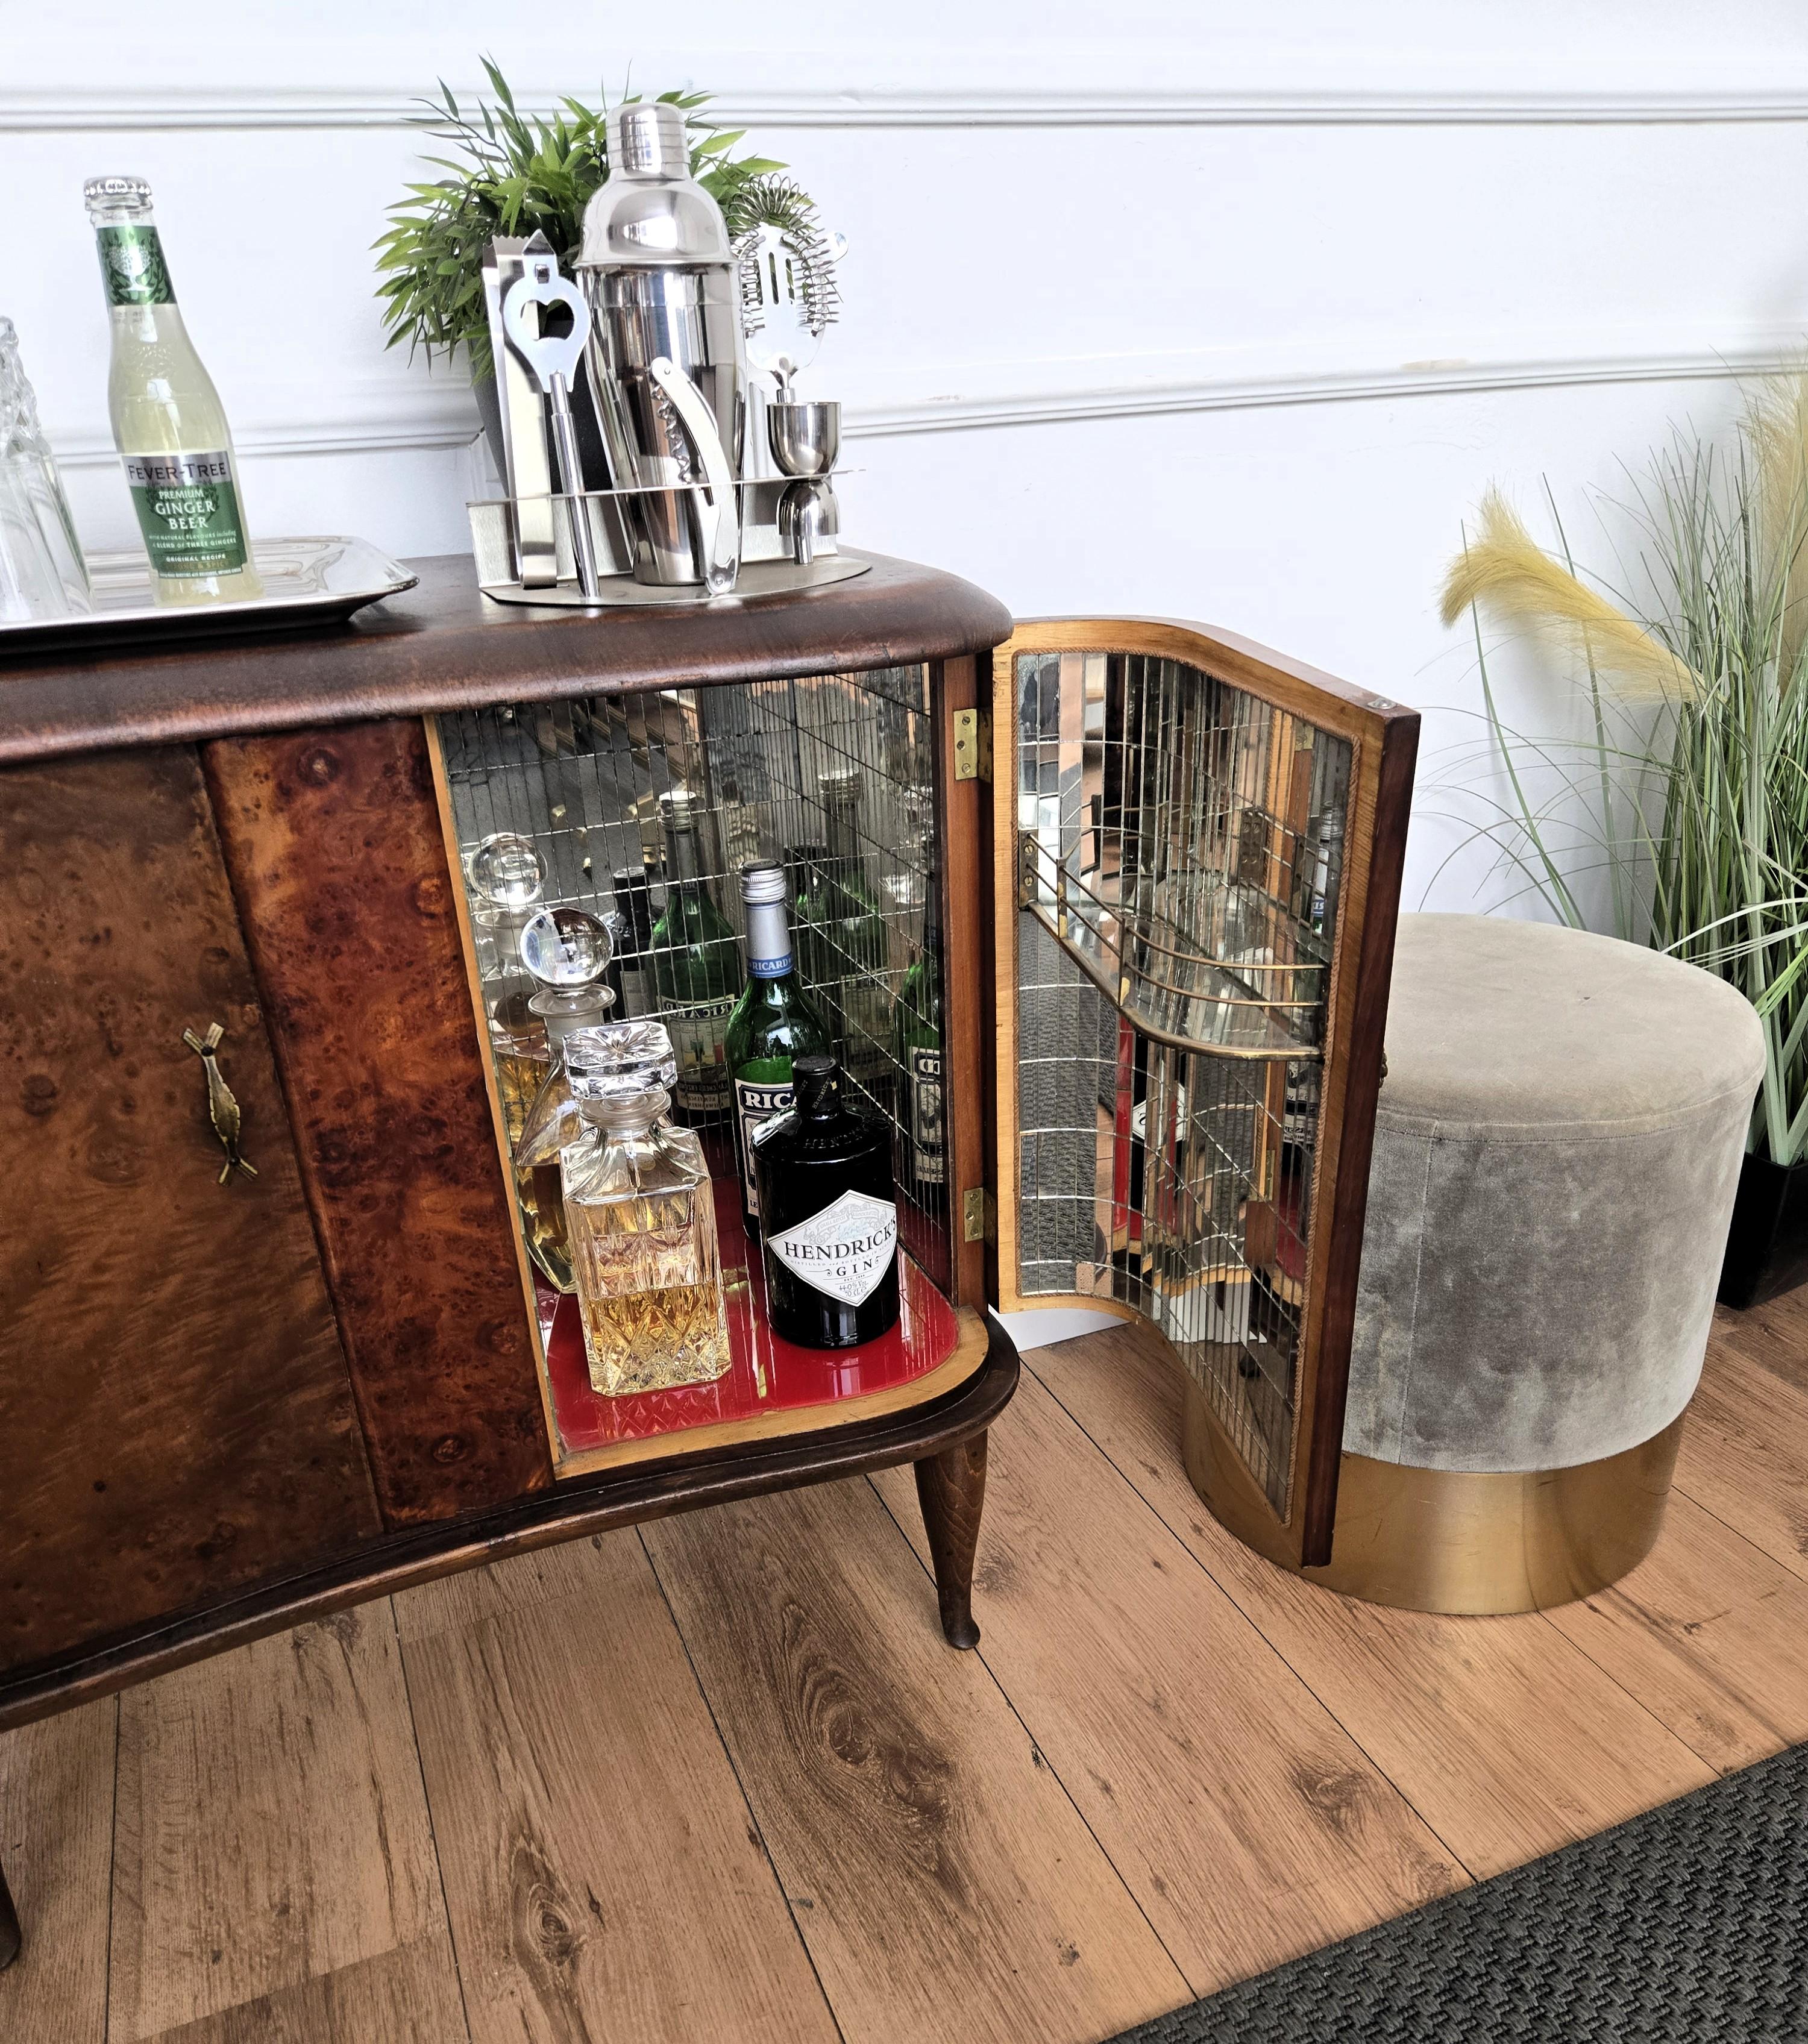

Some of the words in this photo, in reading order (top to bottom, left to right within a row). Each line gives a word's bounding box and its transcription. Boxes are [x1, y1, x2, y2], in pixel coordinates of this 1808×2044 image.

[128, 463, 226, 480] FEVER-TREE
[159, 489, 204, 500] PREMIUM
[155, 501, 216, 515] GINGER
[169, 516, 209, 530] BEER
[752, 959, 788, 971] RICARD
[784, 1215, 896, 1259] HENDRICK'S
[837, 1258, 873, 1276] GIN
